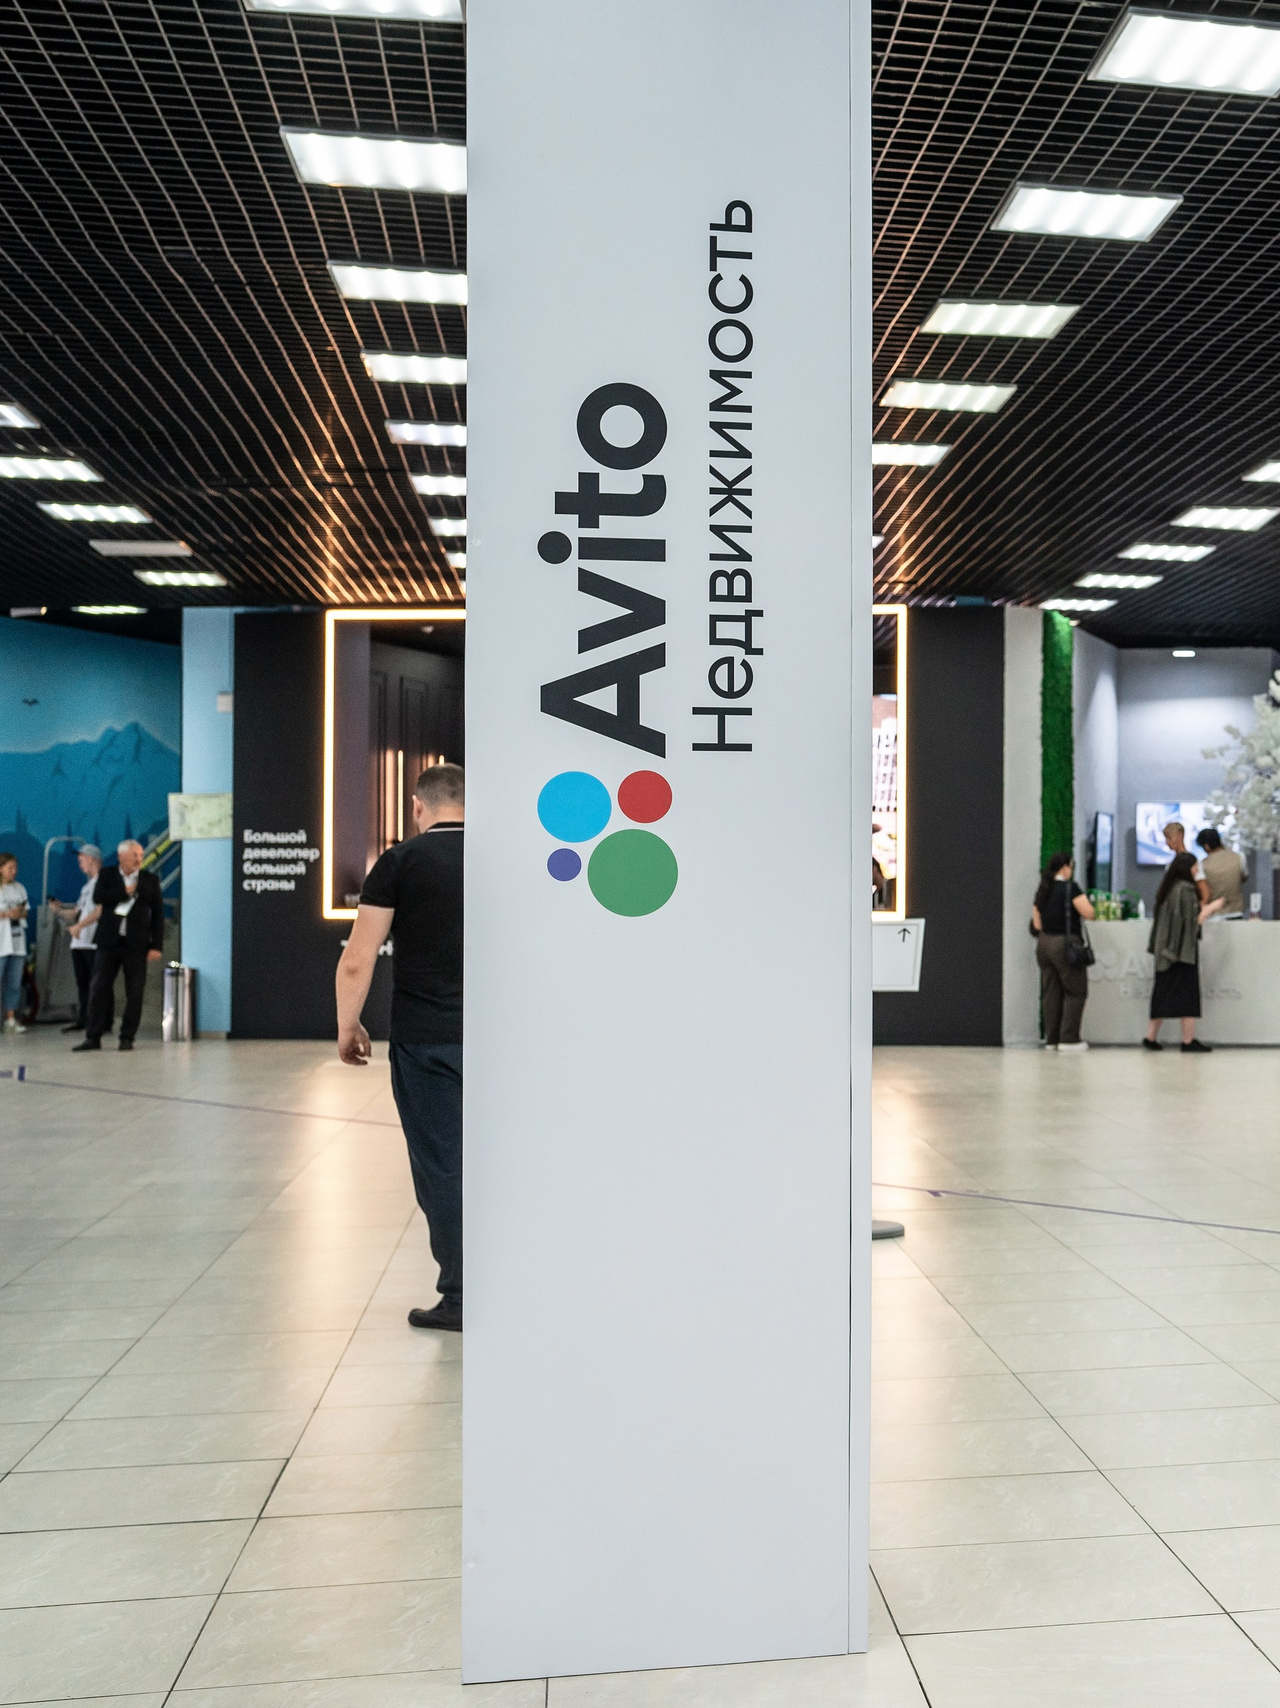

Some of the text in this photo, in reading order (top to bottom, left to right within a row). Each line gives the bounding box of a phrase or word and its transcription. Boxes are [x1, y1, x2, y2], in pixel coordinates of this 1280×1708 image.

[692, 200, 764, 752] Недвижимость
[537, 383, 668, 759] Avito
[243, 829, 307, 844] Большой
[243, 848, 320, 862] девелопер
[243, 861, 306, 875] большой
[243, 879, 295, 893] страны
